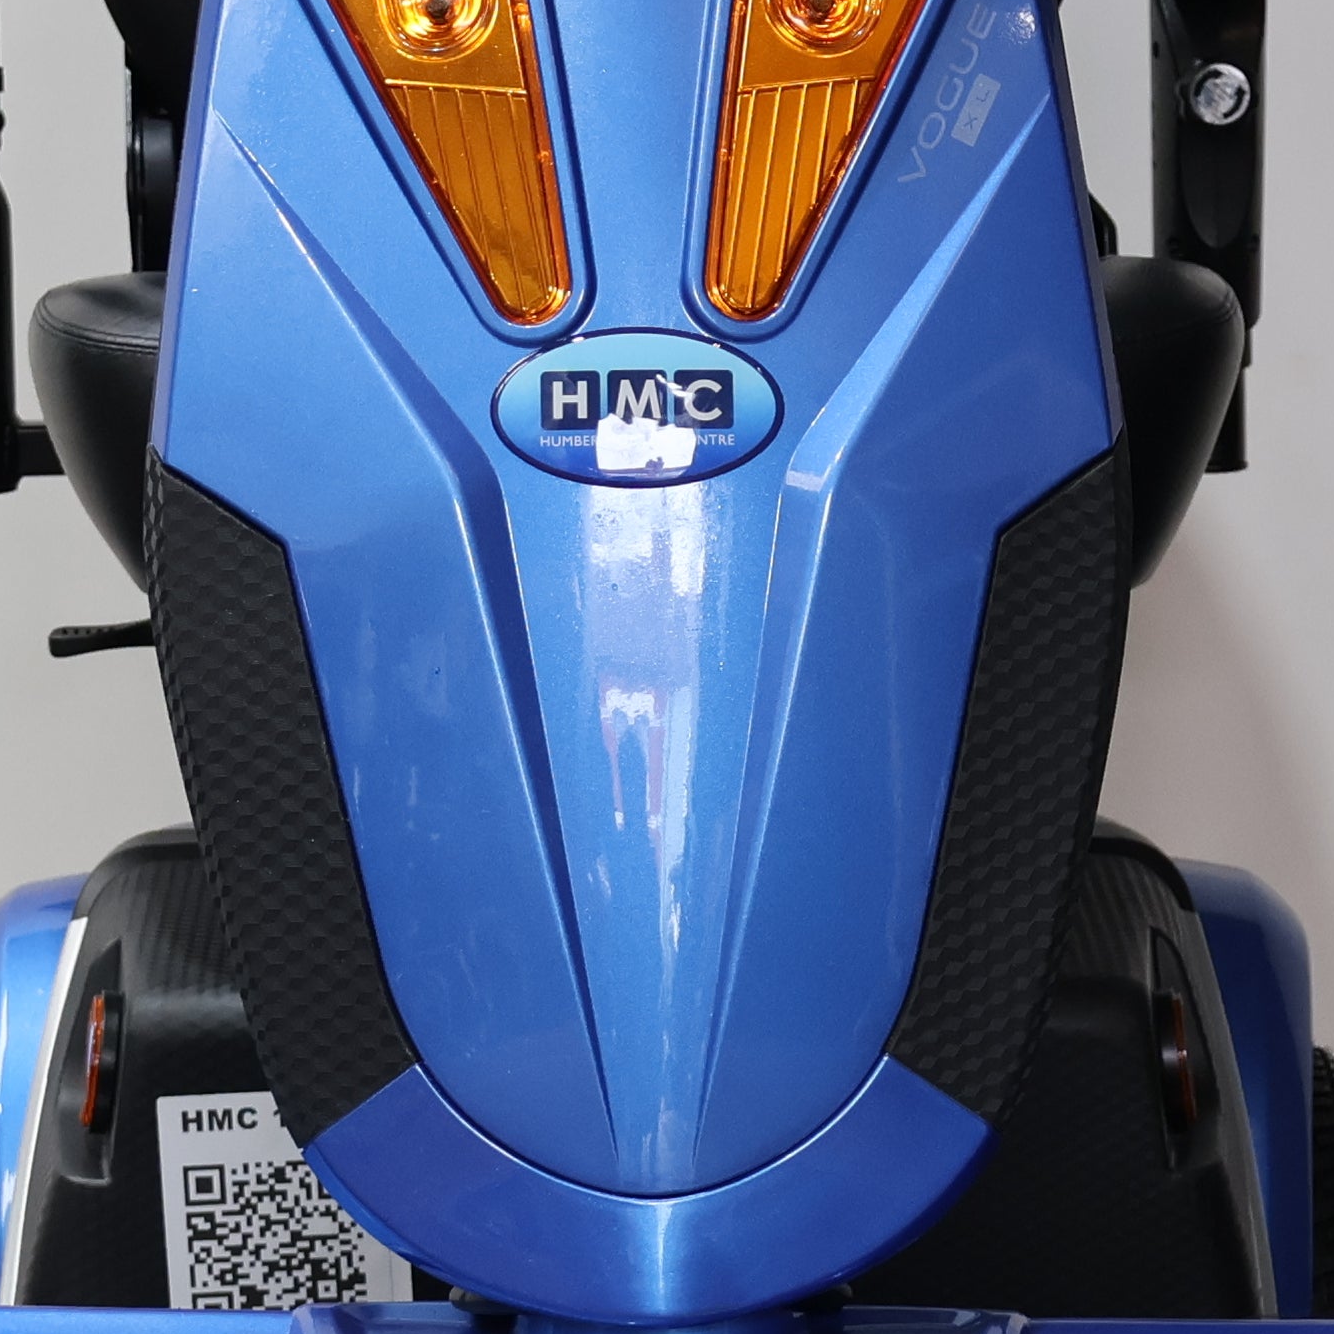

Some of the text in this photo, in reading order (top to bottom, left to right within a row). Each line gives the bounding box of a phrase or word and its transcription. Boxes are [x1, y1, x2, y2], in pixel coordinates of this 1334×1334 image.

[897, 2, 997, 183] VOGUE
[552, 378, 723, 421] HMC
[696, 433, 735, 446] NTRE
[181, 1107, 259, 1132] HMC
